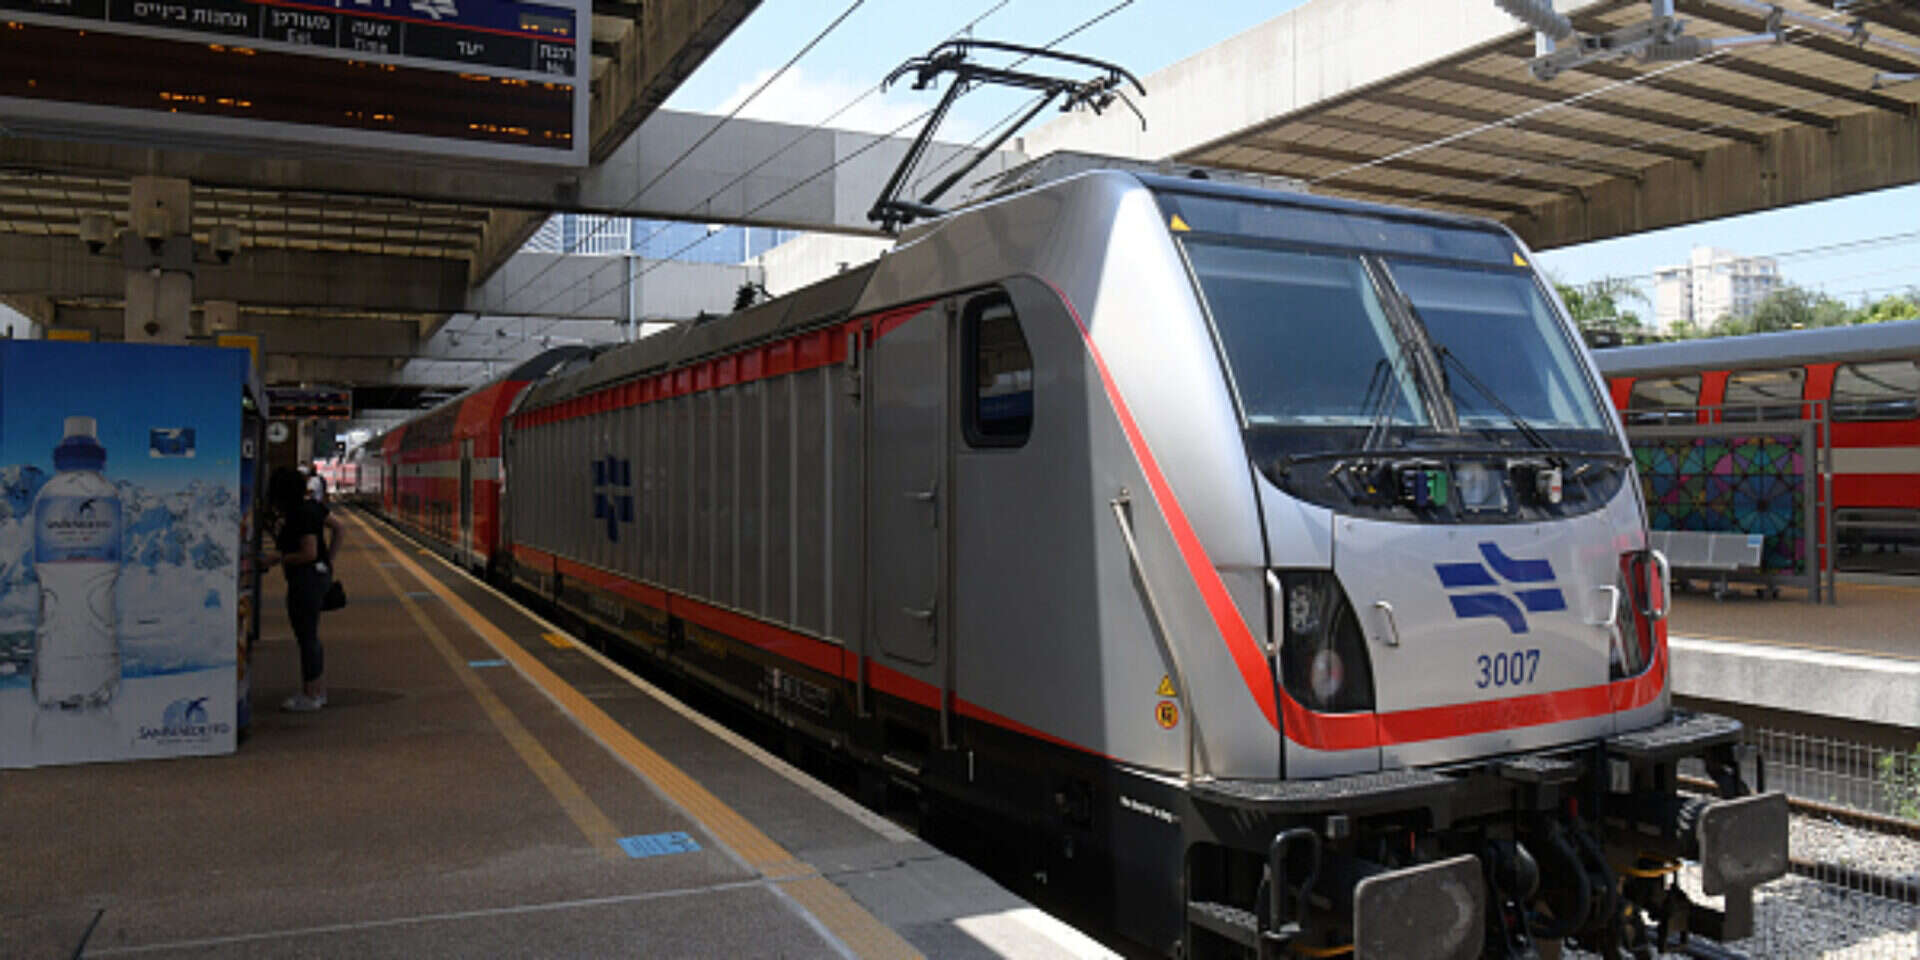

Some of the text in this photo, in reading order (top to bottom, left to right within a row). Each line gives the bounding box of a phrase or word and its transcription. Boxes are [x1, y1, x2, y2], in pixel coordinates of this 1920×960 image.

[134, 2, 248, 28] תחנות ביניים
[351, 20, 392, 37] שעה
[456, 40, 485, 55] יעד
[1476, 649, 1541, 688] 3007
